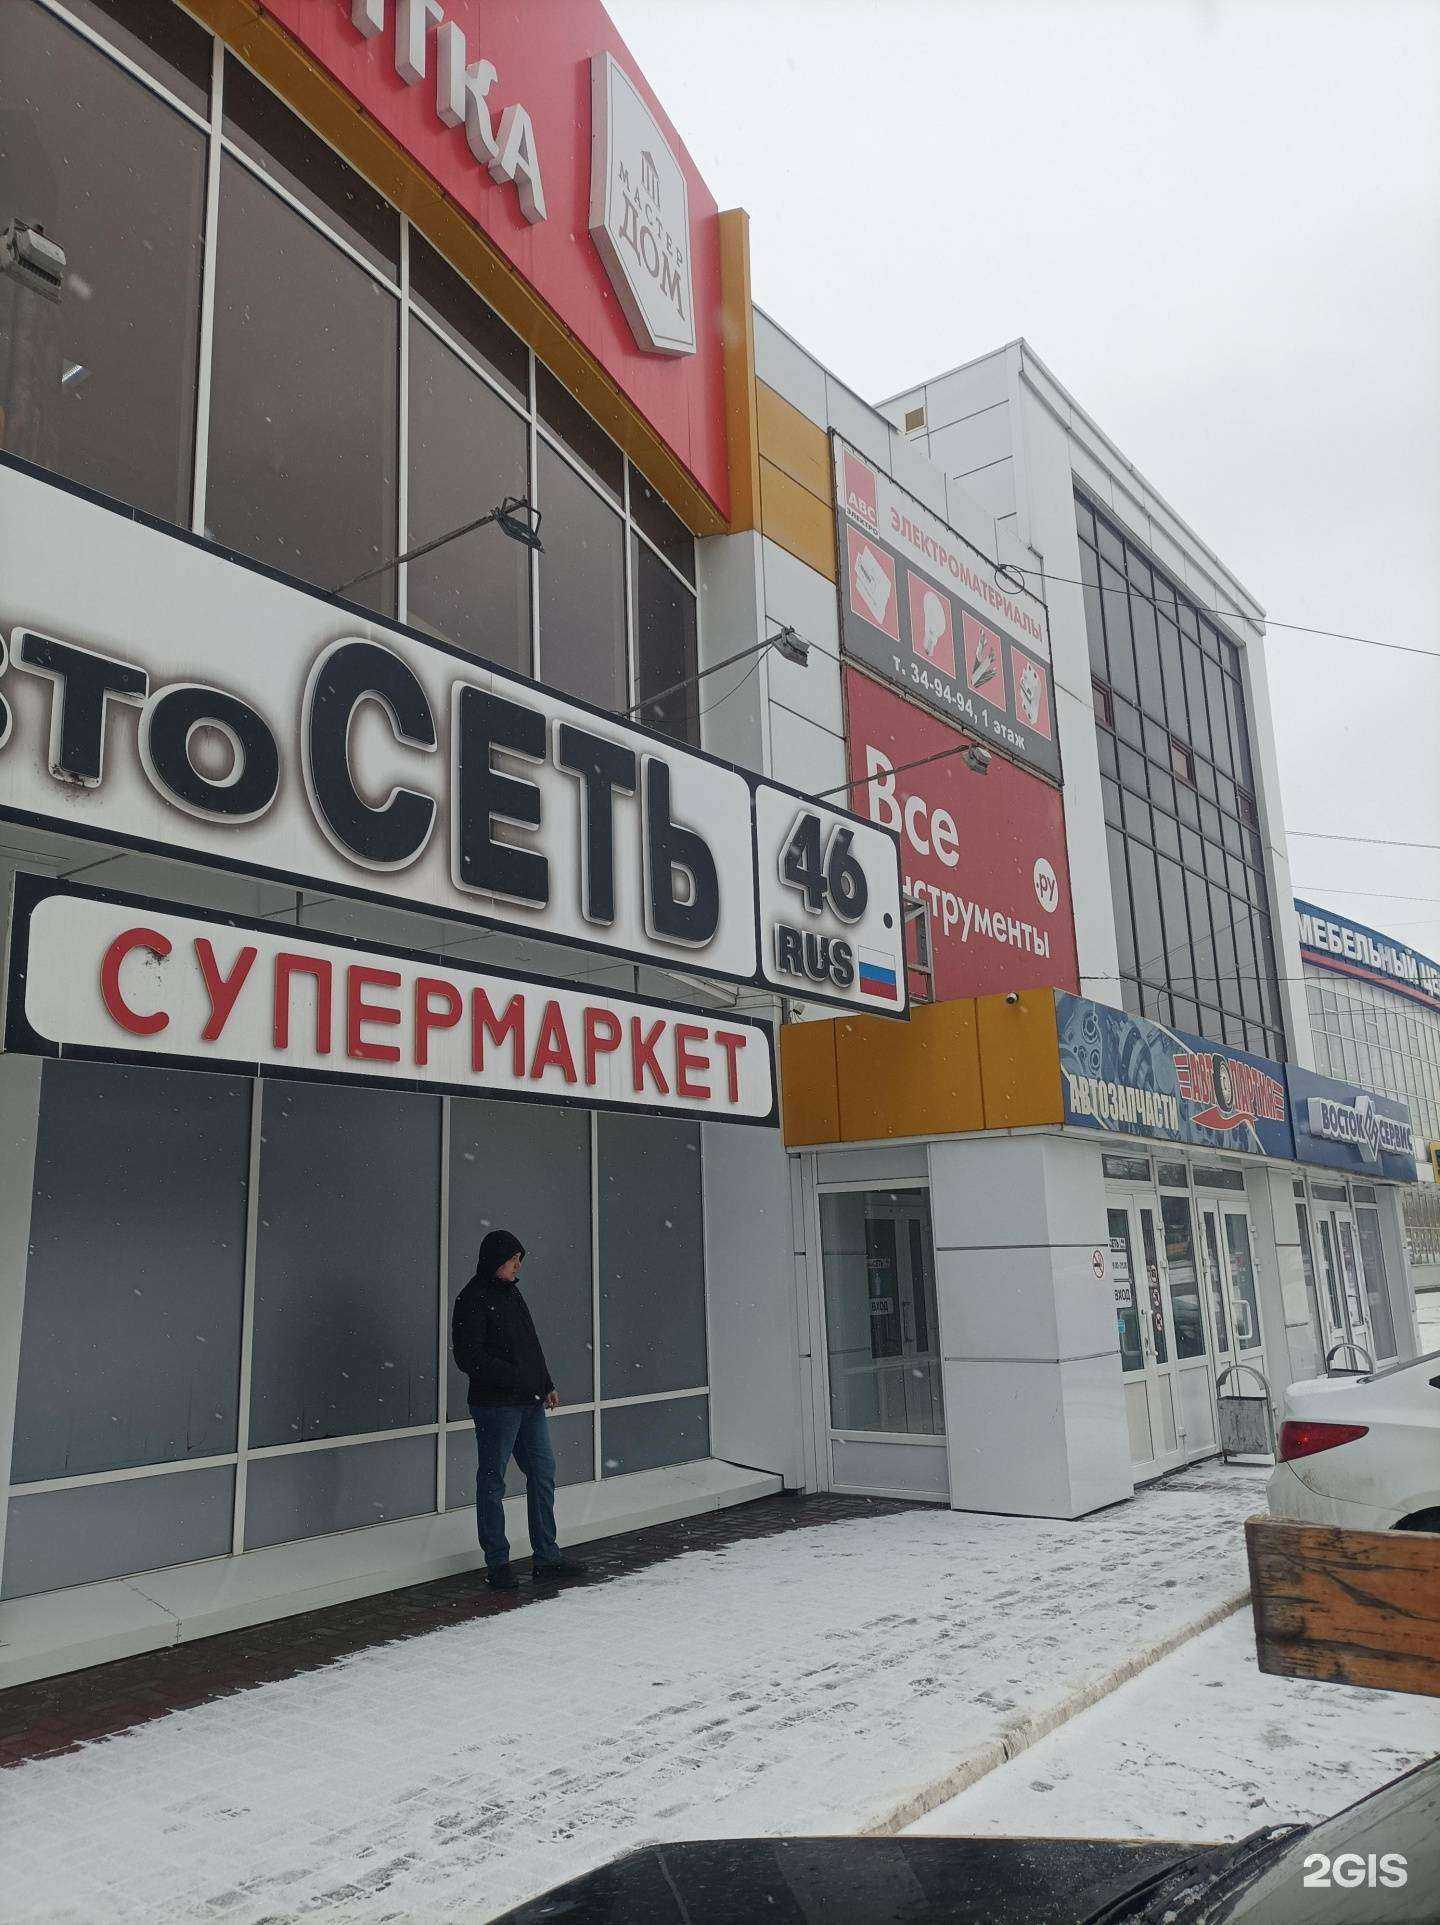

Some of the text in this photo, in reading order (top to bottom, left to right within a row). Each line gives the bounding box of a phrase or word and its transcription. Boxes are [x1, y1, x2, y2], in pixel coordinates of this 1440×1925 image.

[351, 0, 547, 224] ТКА
[619, 160, 683, 267] МАСТЕР
[619, 191, 685, 321] ДОМ
[890, 506, 1043, 643] ЭЛЕКТРОМАТЕРИАЛЫ
[911, 663, 978, 724] 34-94-94,
[982, 709, 988, 727] 1
[993, 720, 1026, 751] этаж
[0, 627, 719, 949] тоСЕТЬ
[866, 744, 960, 866] Все
[779, 811, 868, 924] 46
[903, 876, 1050, 959] струменты
[775, 923, 854, 988] RUS
[100, 927, 747, 1103] СУПЕРМАРКЕТ
[1069, 1073, 1179, 1131] АВТОЗАПЧАСТИ
[1321, 1102, 1413, 1151] ВОСТОК СЕРВИС
